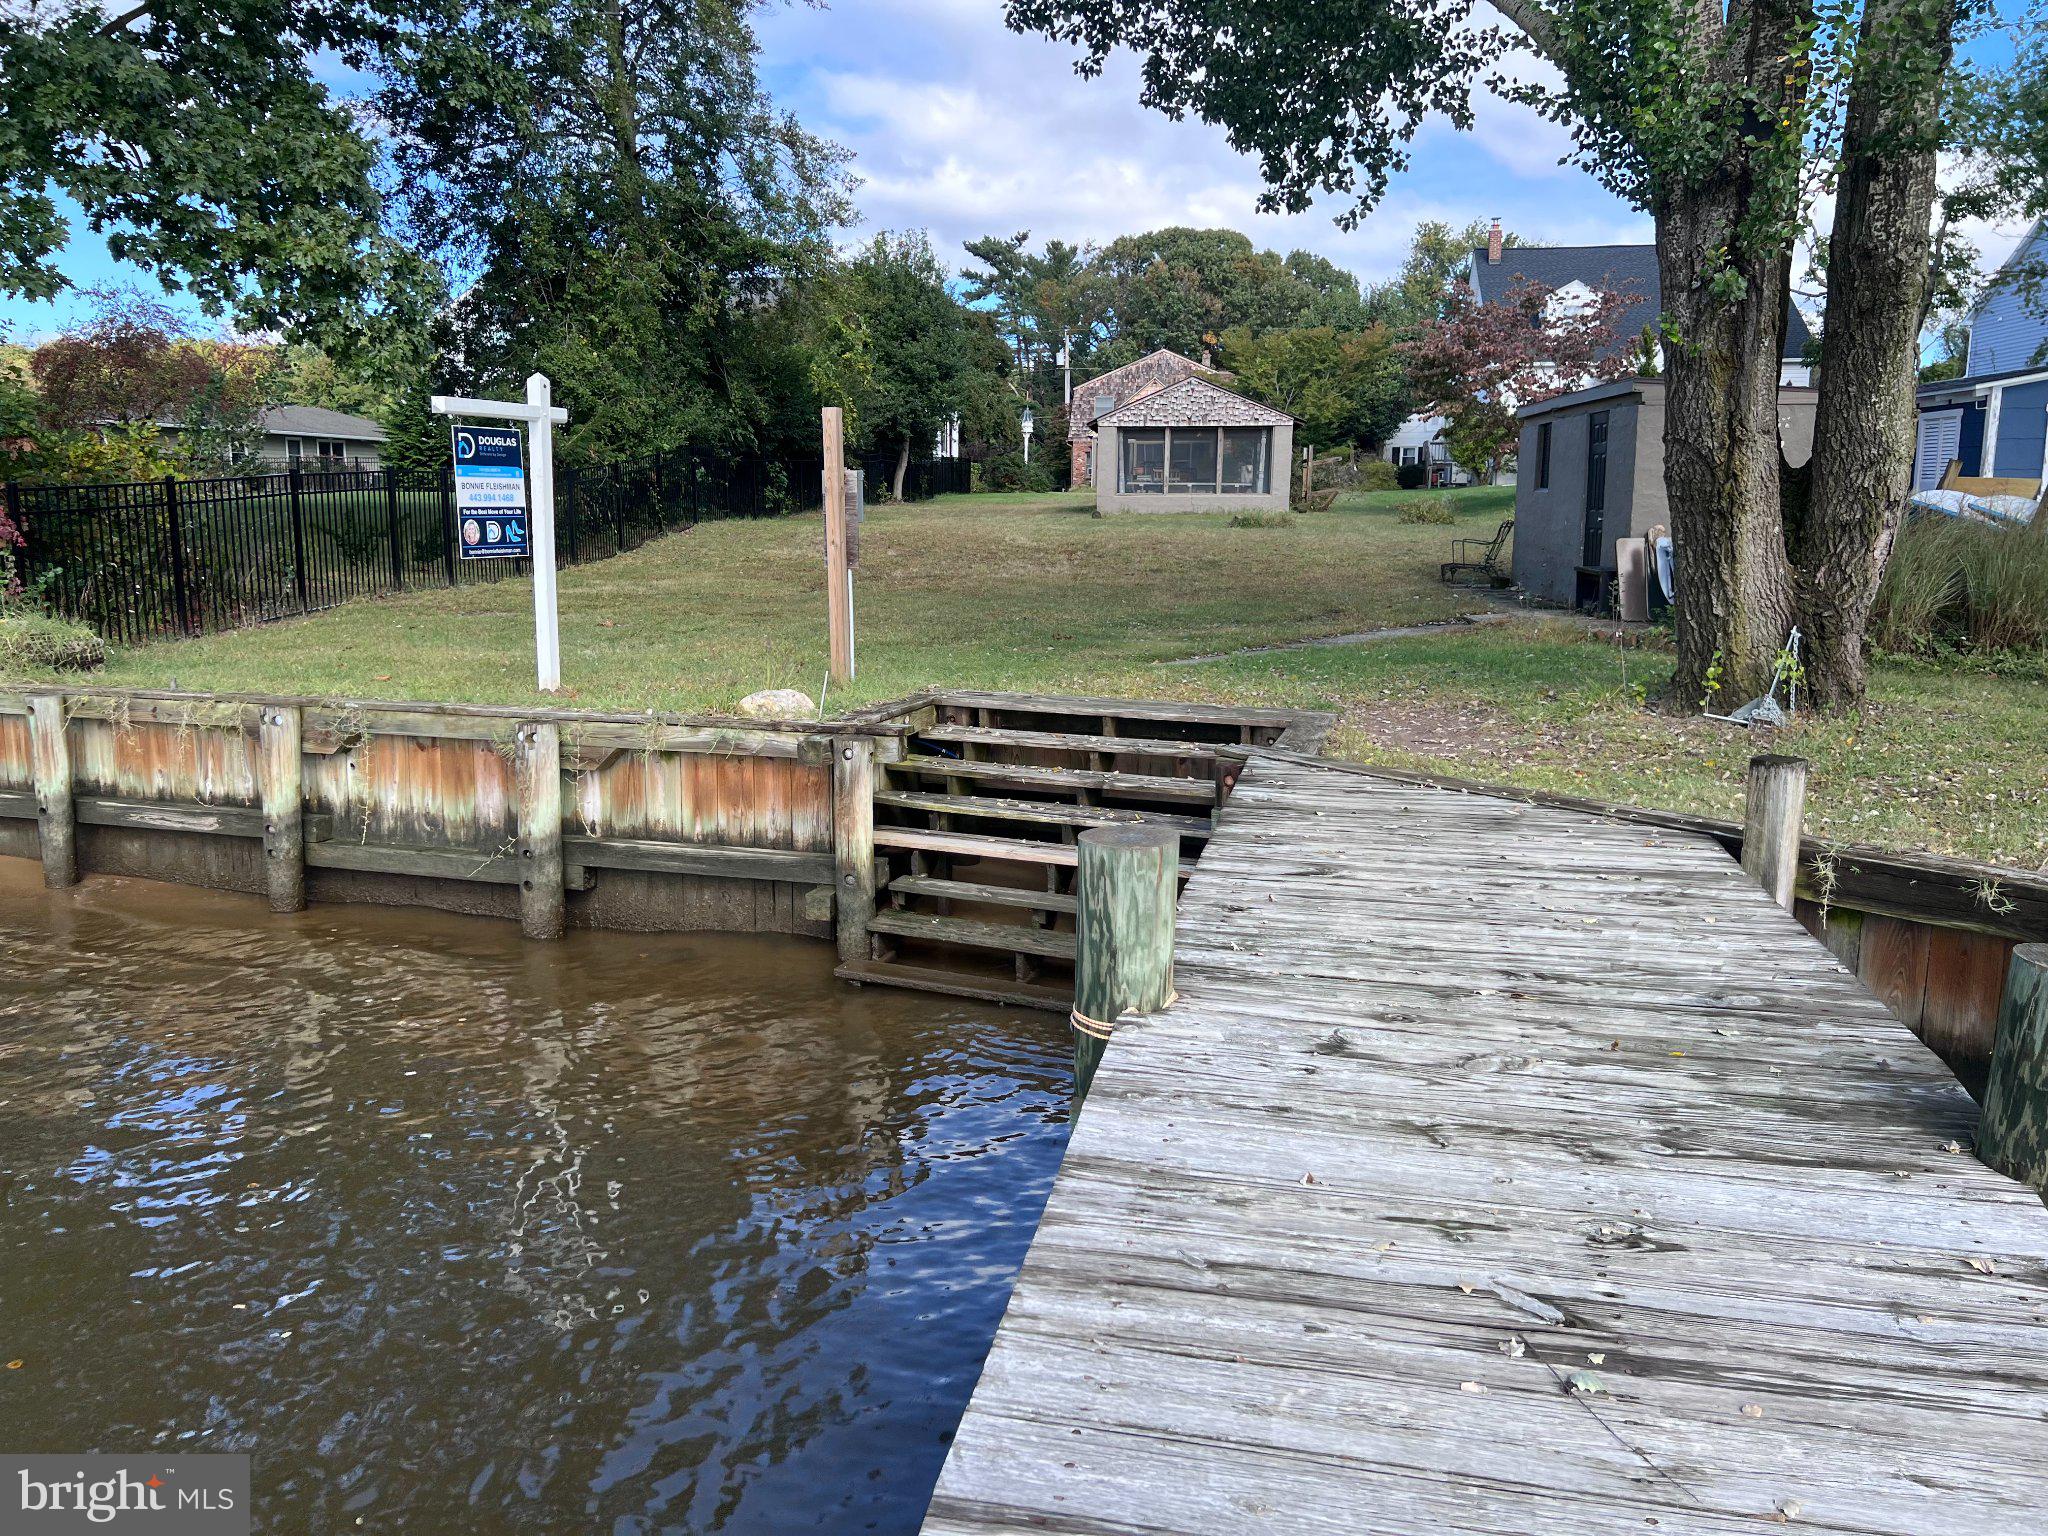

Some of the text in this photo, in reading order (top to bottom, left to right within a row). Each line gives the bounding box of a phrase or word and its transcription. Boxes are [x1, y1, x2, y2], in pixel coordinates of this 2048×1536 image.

[478, 435, 517, 447] DOUGLAS
[461, 482, 521, 491] BONNIE FLEISHMAN
